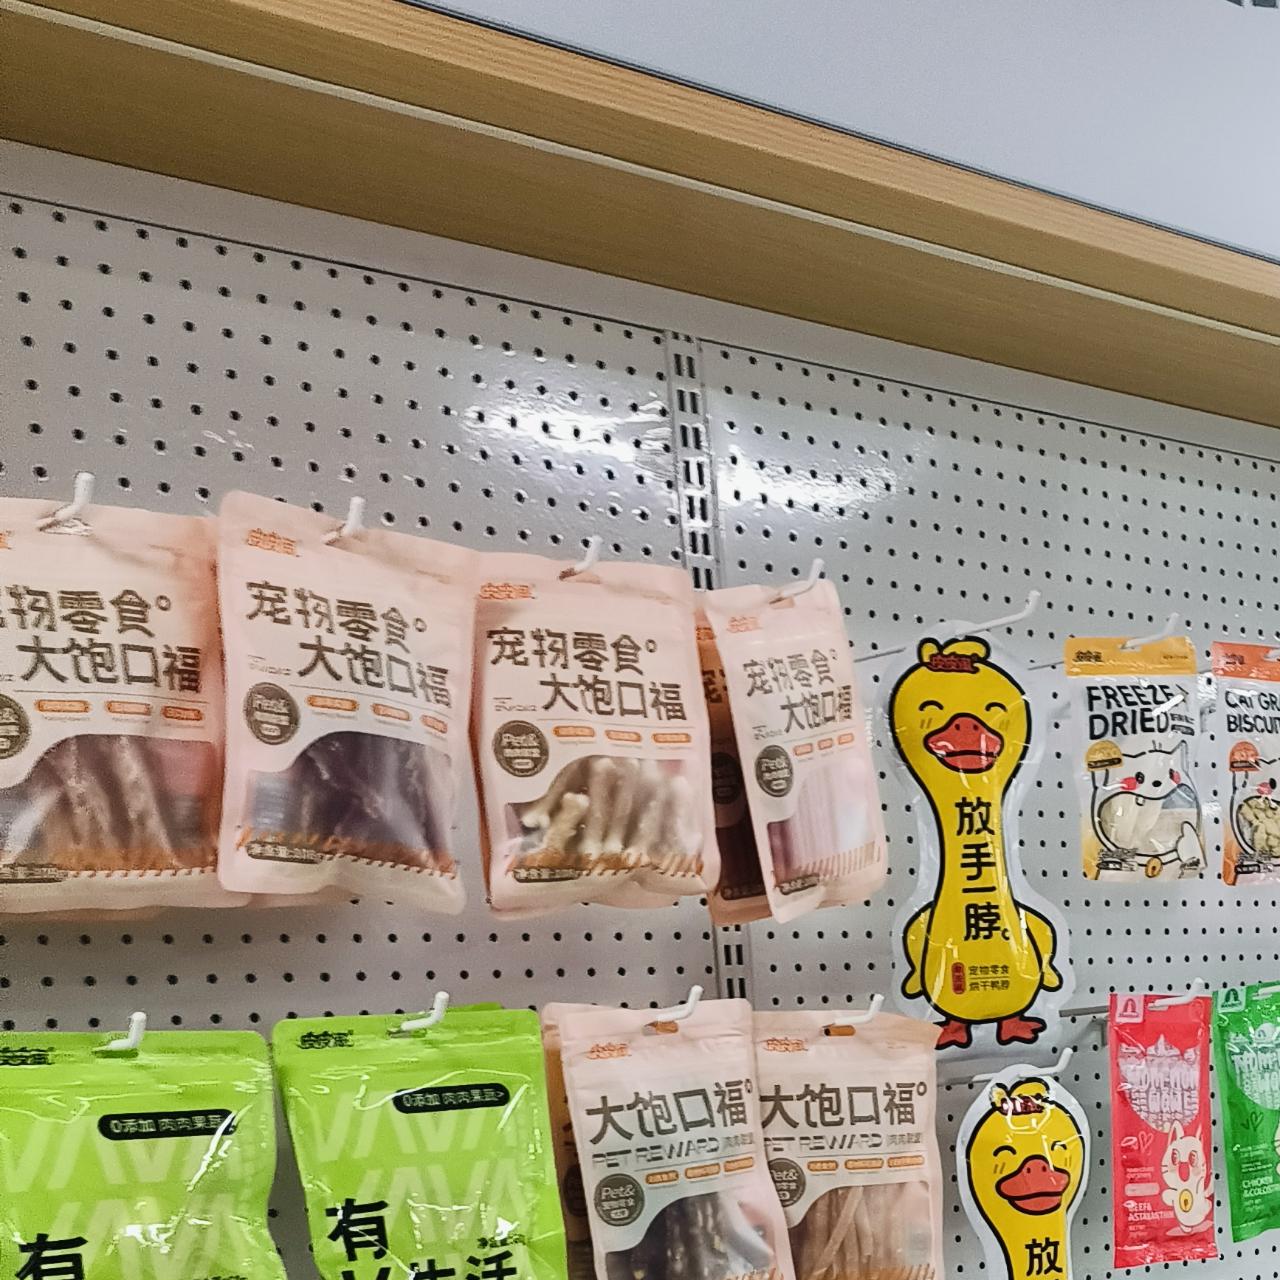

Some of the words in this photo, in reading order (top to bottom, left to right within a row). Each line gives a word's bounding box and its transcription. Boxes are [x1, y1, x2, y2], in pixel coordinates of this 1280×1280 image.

[16, 636, 201, 694] 大饱口福
[298, 636, 452, 708] 大饱口福
[539, 674, 687, 721] 大饱口福
[780, 684, 853, 734] 大饱口福
[1089, 709, 1169, 740] DRIED
[326, 1198, 389, 1262] 有
